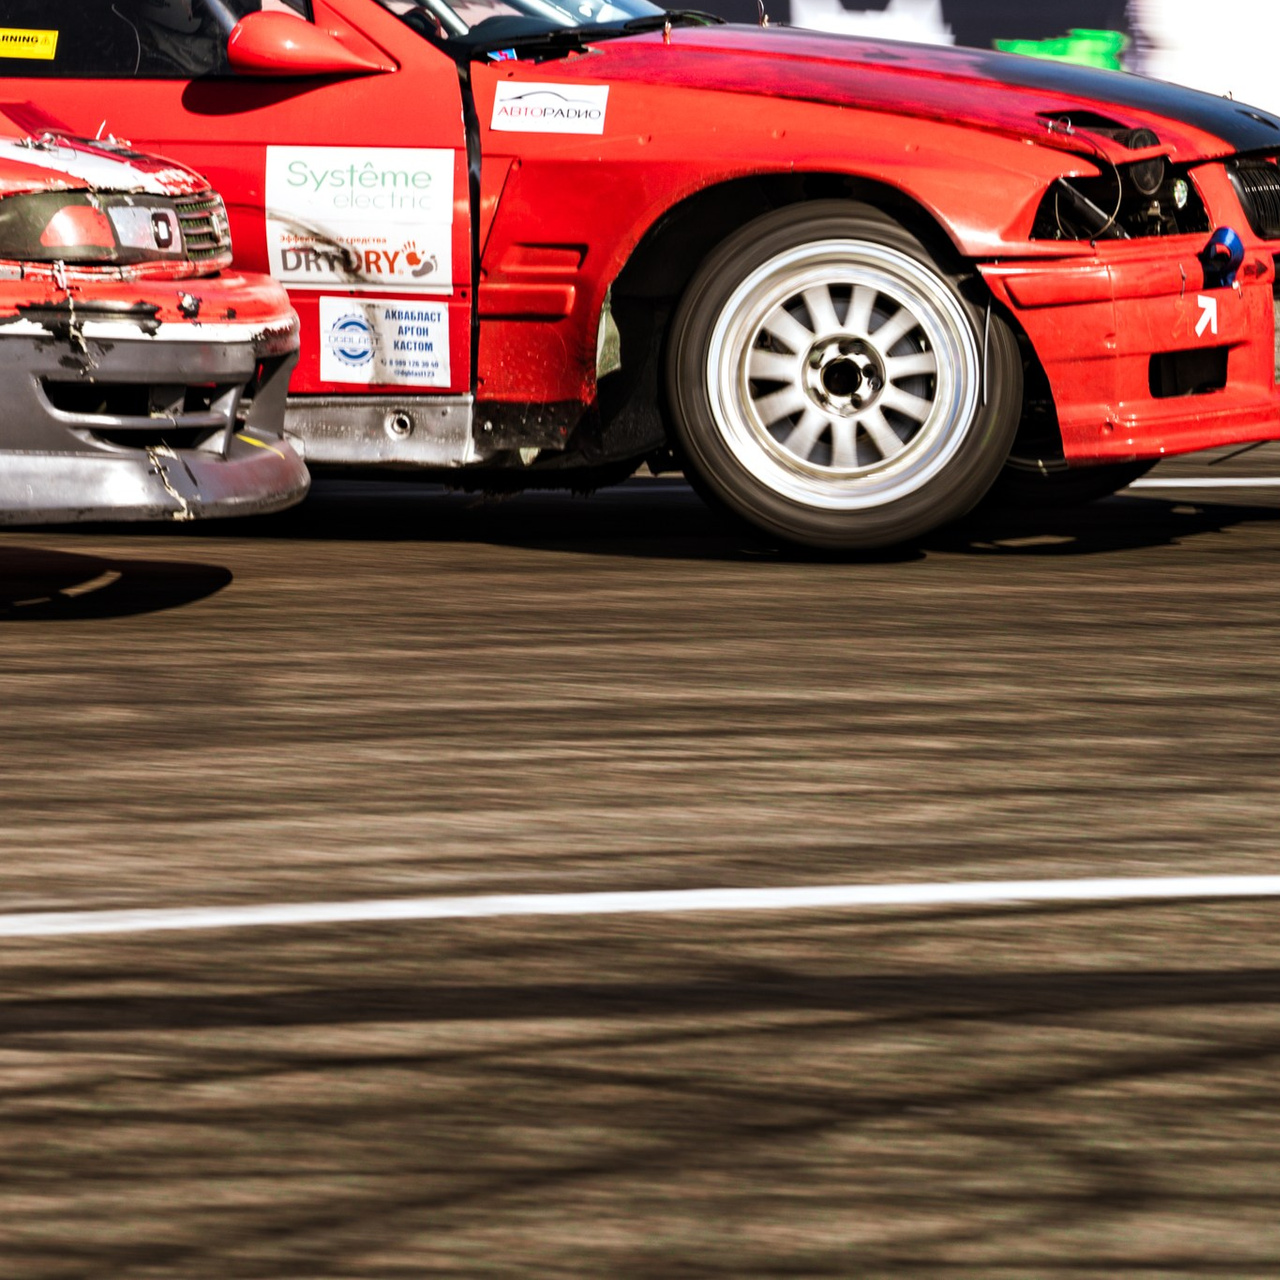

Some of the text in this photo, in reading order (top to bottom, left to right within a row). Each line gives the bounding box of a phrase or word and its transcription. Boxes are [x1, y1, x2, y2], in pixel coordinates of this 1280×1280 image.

[287, 160, 433, 193] Systême
[333, 188, 432, 210] electric
[385, 309, 441, 322] АКВАБЛАСТ
[398, 325, 429, 337] АРГОН
[394, 340, 434, 352] КАСТОМ
